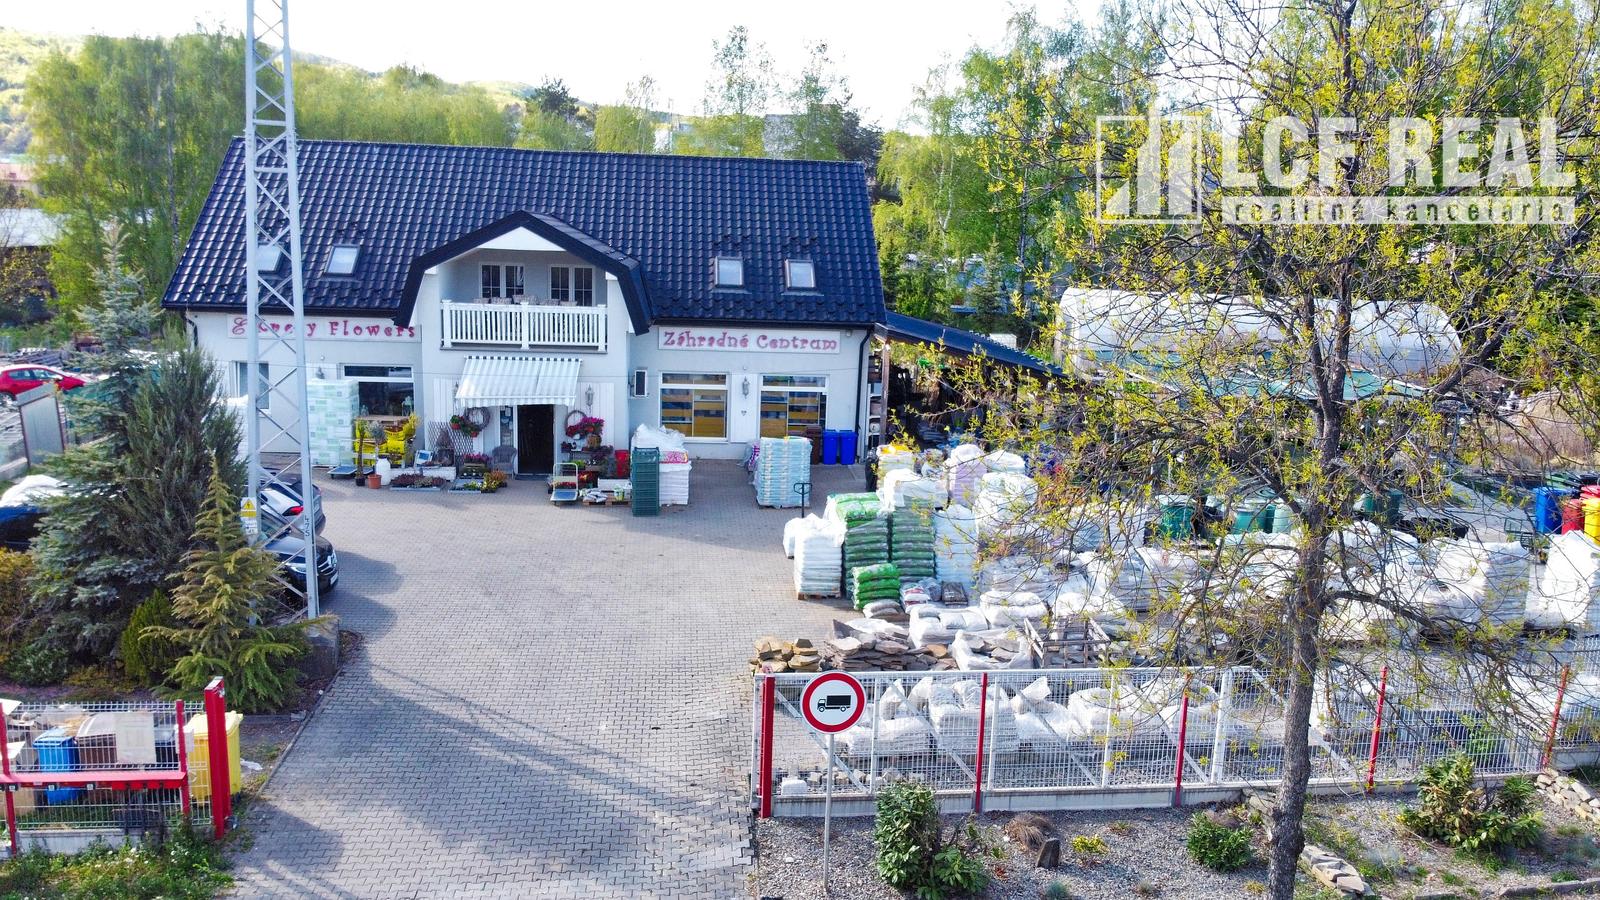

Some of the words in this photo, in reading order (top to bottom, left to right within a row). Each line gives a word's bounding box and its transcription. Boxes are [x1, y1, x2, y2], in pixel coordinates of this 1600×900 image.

[328, 320, 415, 338] Flowers
[663, 330, 750, 349] Záhradné
[756, 334, 838, 351] Centrum
